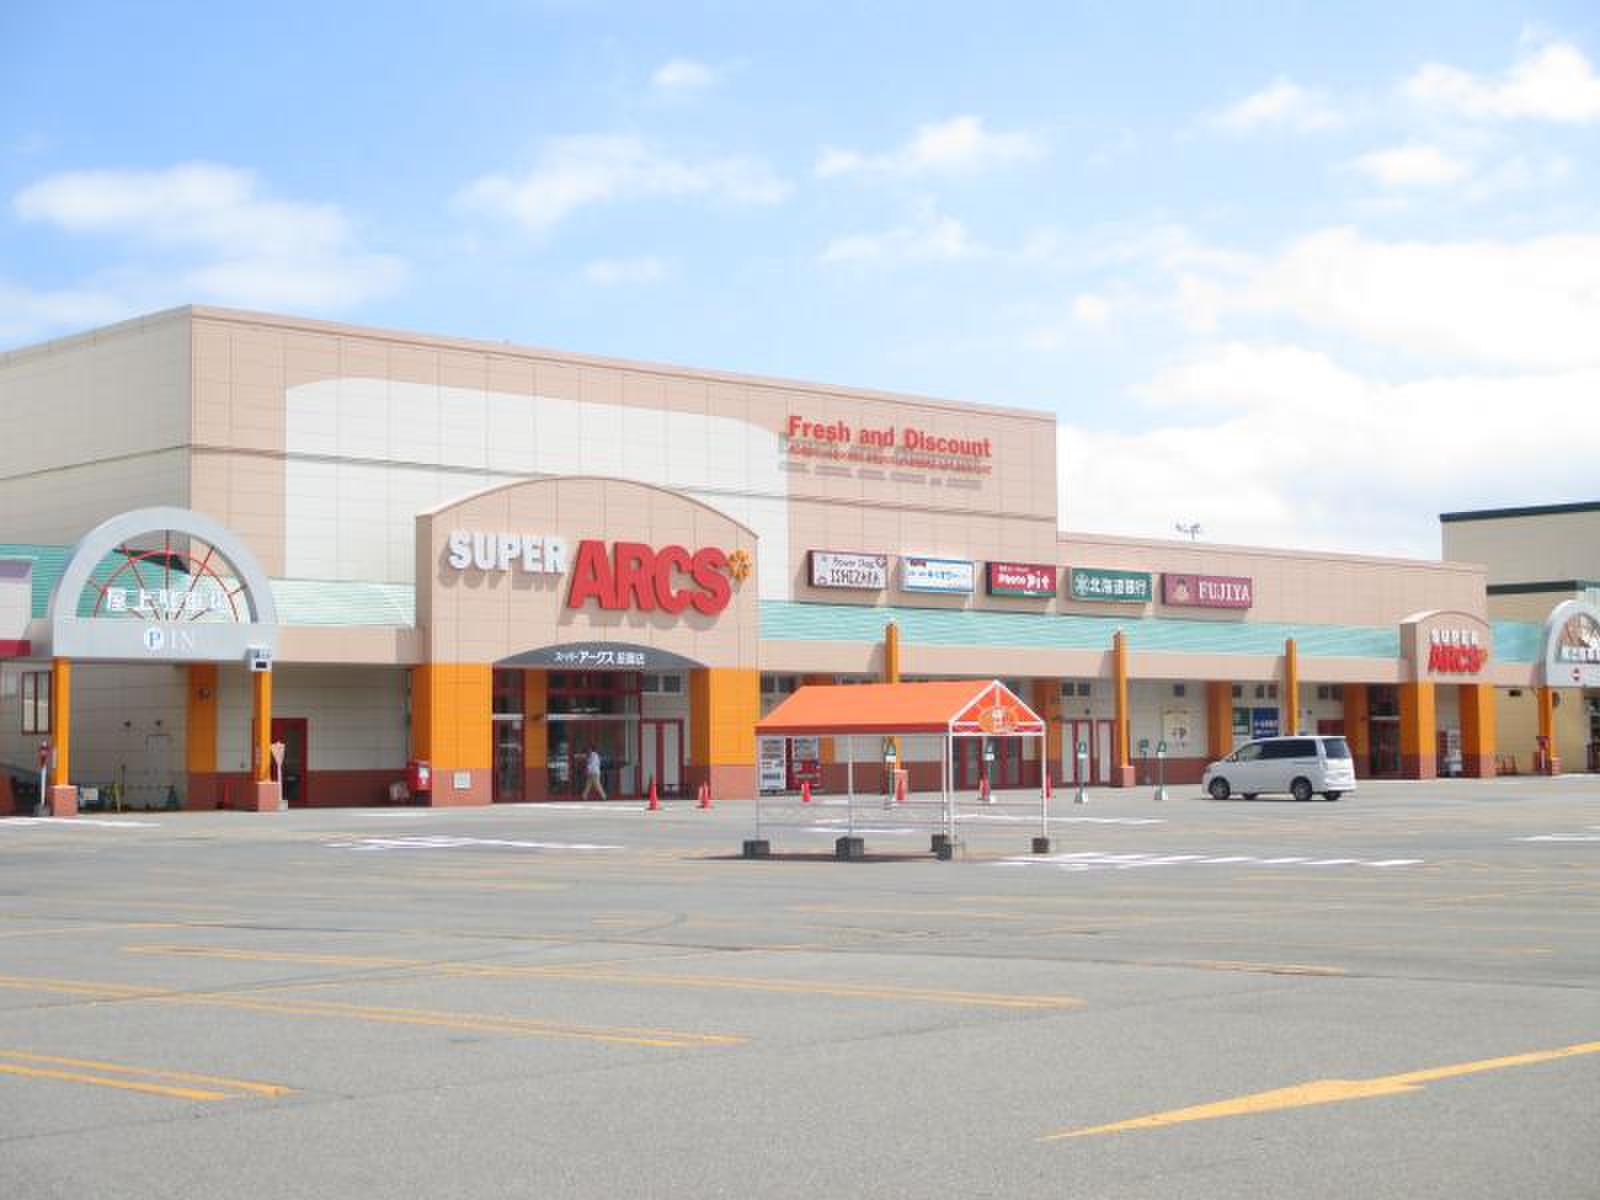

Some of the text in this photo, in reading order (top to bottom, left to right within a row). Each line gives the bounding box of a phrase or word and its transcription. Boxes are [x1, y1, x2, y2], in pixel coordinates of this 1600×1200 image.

[788, 416, 850, 442] Fresh
[860, 426, 895, 447] and
[904, 428, 992, 457] Discount
[452, 532, 731, 614] SUPER ARCS
[1199, 581, 1250, 602] FUJIYA
